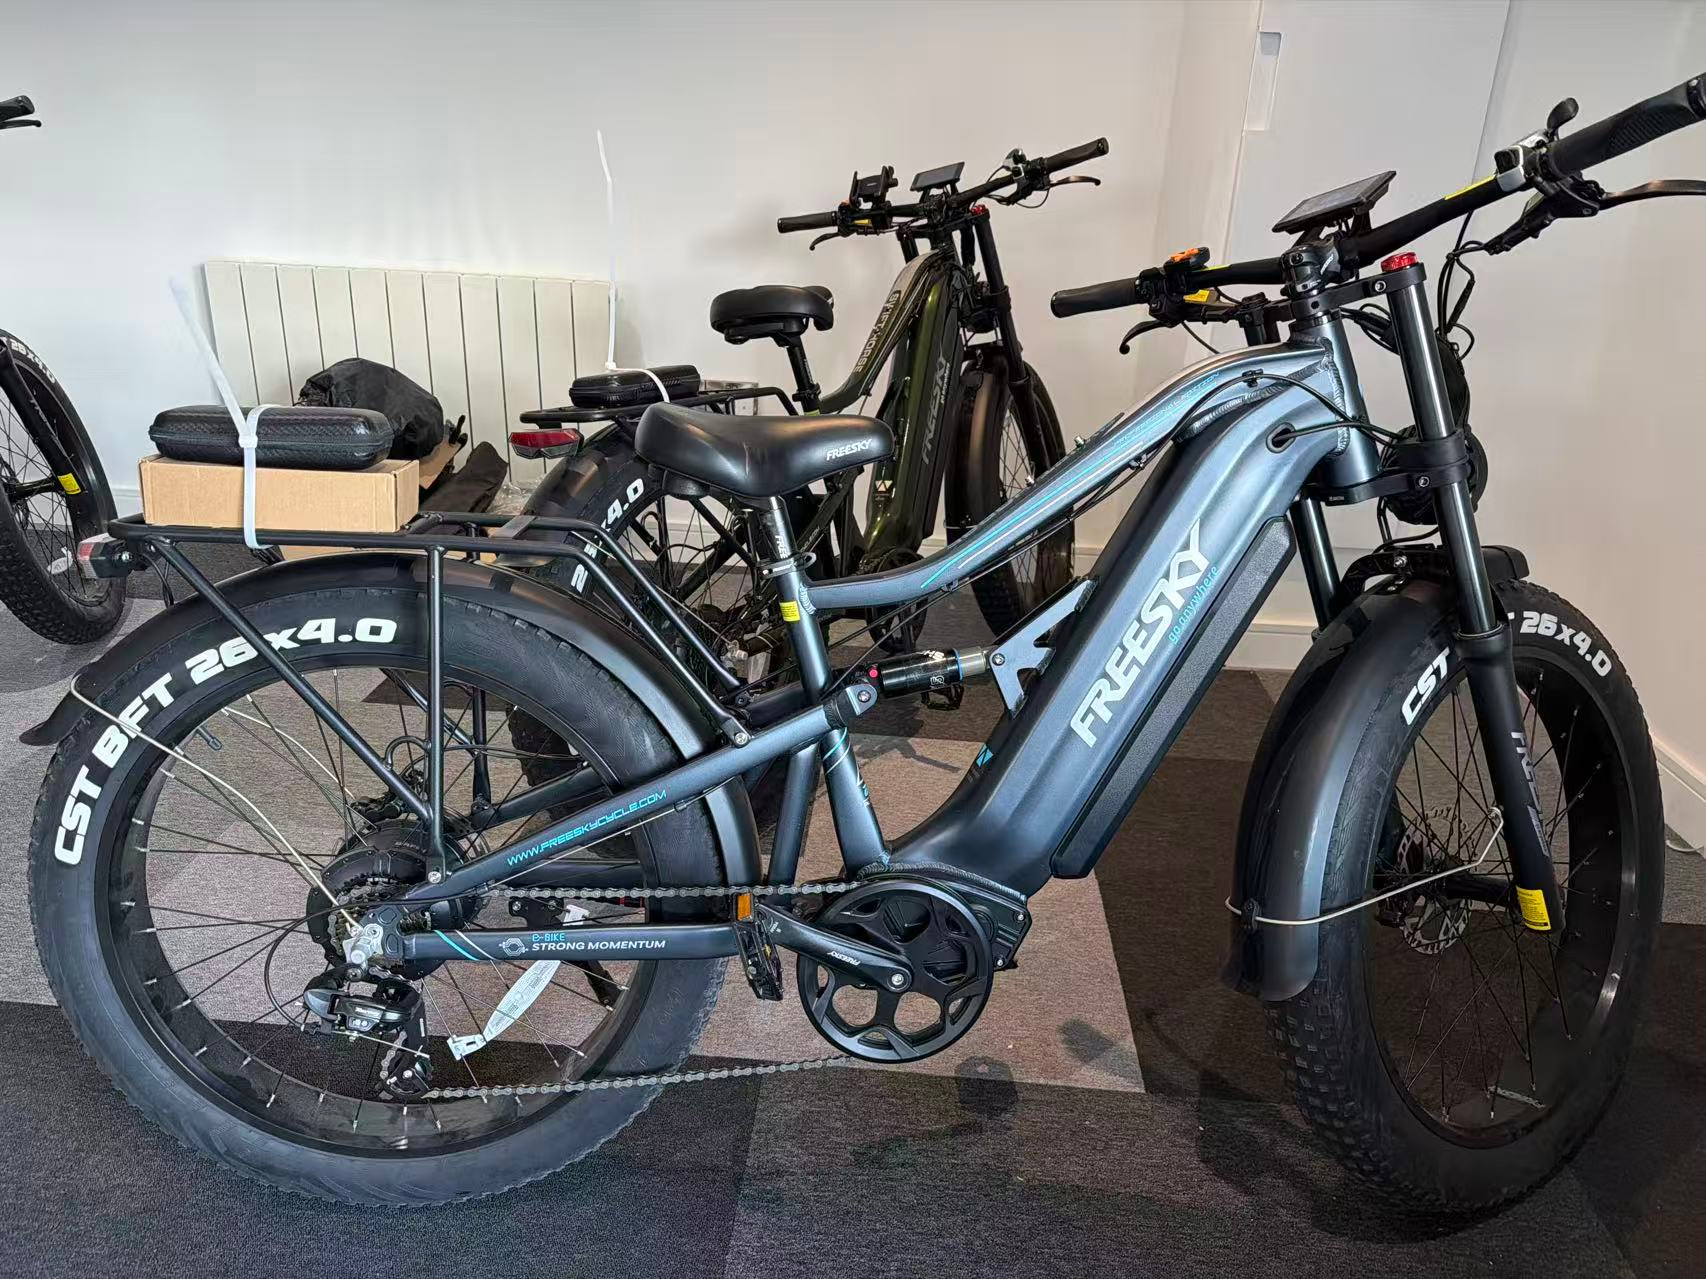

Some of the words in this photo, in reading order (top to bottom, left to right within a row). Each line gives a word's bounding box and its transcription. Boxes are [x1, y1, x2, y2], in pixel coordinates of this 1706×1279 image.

[826, 438, 873, 461] FREESKY
[921, 340, 947, 465] FREESKY
[1070, 518, 1211, 748] FREESKY
[1168, 625, 1181, 645] go
[1179, 566, 1220, 626] anywhere
[1401, 646, 1451, 726] CST
[1519, 611, 1613, 677] 26x4.0
[54, 764, 102, 866] CST
[91, 672, 175, 769] BFT
[184, 617, 398, 686] 26x4.0
[507, 789, 667, 866] WWW.FREESKYCYCLE.COM
[532, 942, 585, 951] STRONG
[588, 940, 666, 951] MOMENTUM
